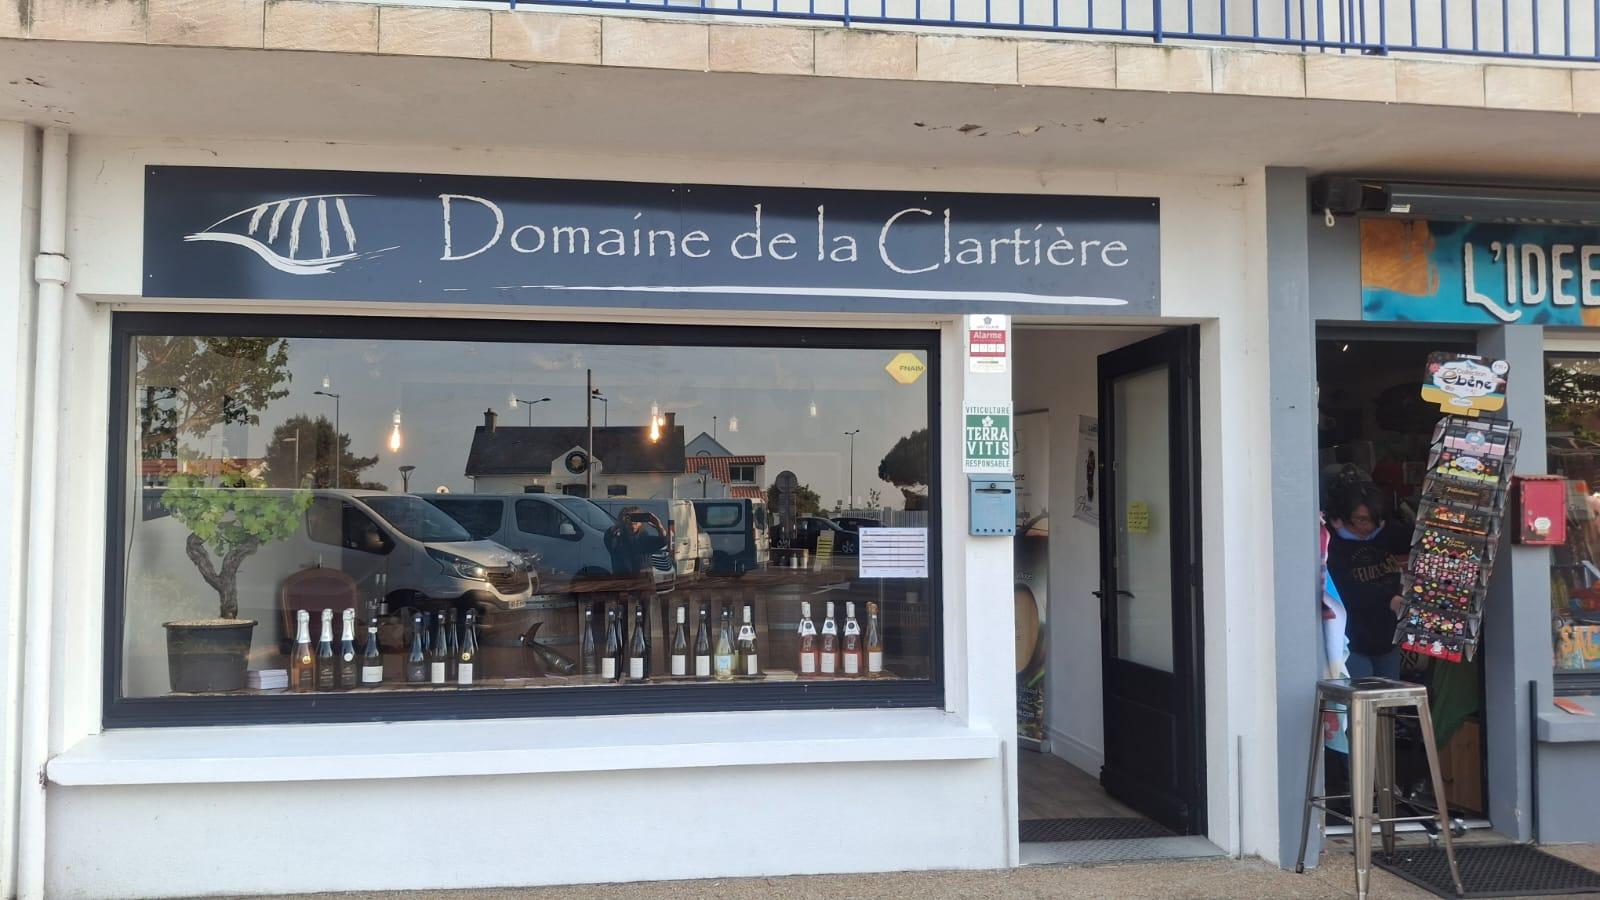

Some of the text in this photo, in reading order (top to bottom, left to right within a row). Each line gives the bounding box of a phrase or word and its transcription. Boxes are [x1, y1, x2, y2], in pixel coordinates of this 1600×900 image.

[438, 193, 1130, 275] Domaine de la Clartière
[973, 331, 1002, 339] Alarme
[965, 406, 1010, 414] VITICULTURE
[967, 427, 1008, 441] TERRA
[967, 441, 1009, 455] VITIS
